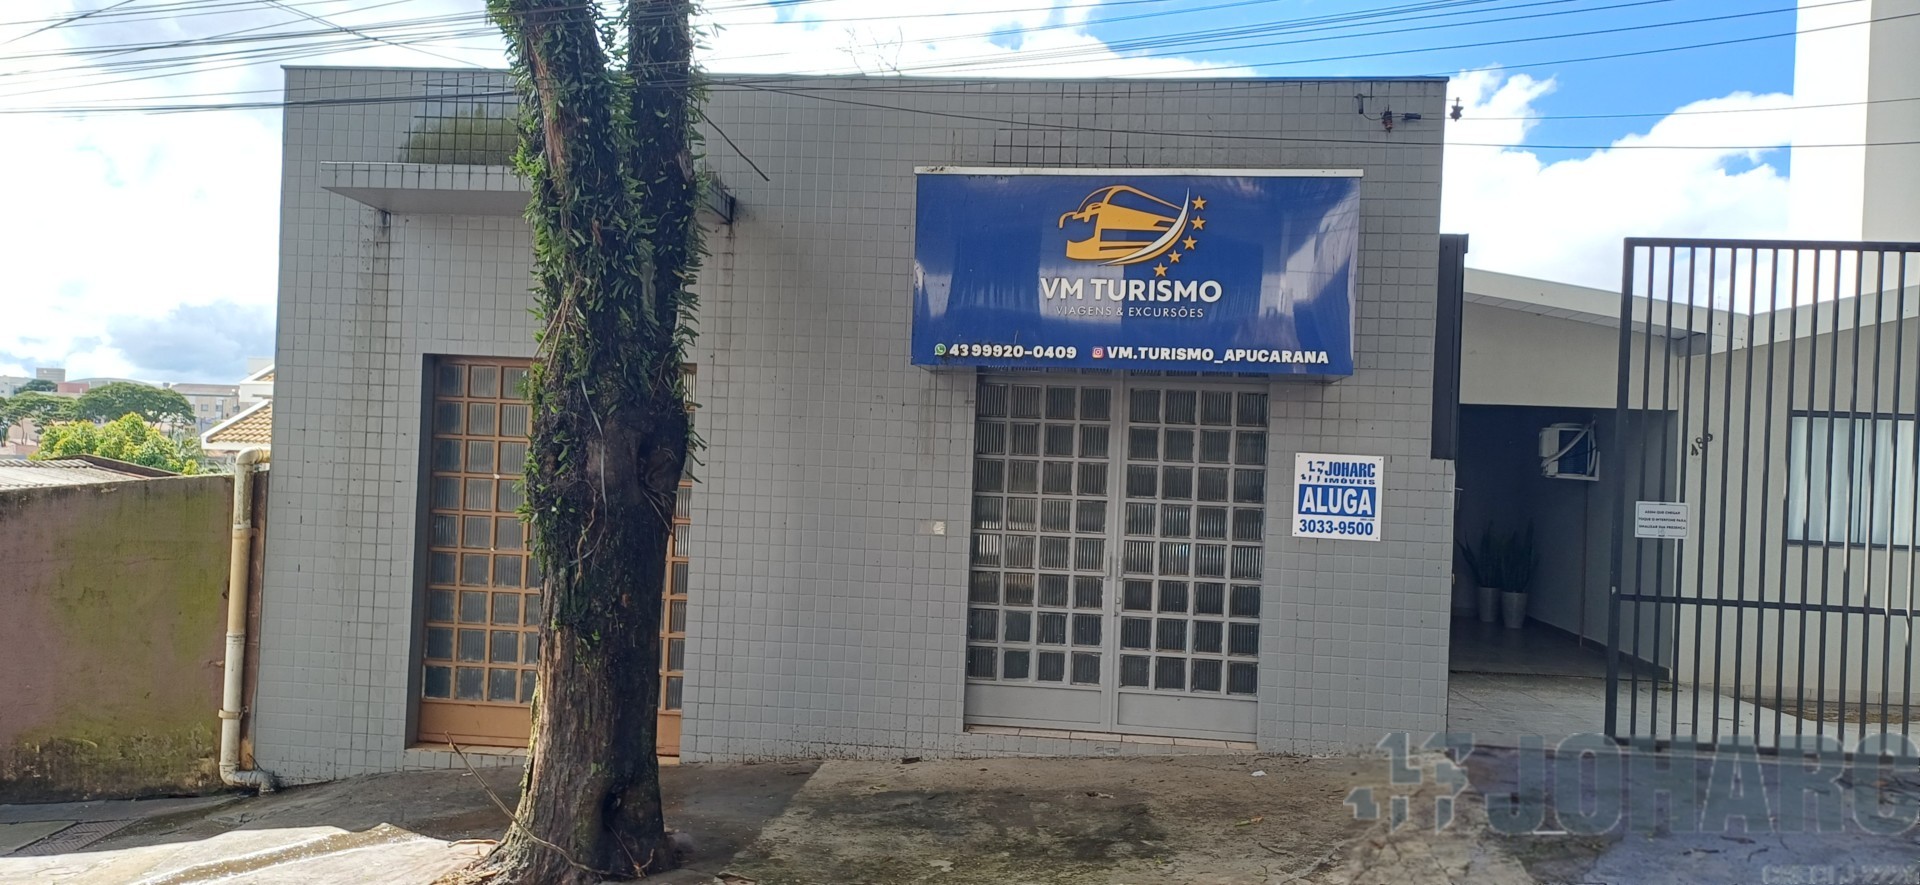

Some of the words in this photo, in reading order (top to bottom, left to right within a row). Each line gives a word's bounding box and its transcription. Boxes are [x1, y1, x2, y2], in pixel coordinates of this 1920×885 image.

[1040, 277, 1083, 300] VM
[1090, 278, 1222, 303] TURISMO
[1056, 305, 1112, 316] VIAGENS
[1116, 307, 1124, 316] &
[1128, 306, 1204, 318] EXCURSÕES
[949, 344, 969, 356] 43
[971, 344, 1077, 359] 99920-0409
[1107, 346, 1329, 364] VM.TURISMO_APUCARANA
[1324, 461, 1375, 477] JOHARC
[1300, 486, 1372, 515] ALUGA
[1299, 519, 1373, 535] 3033-9500
